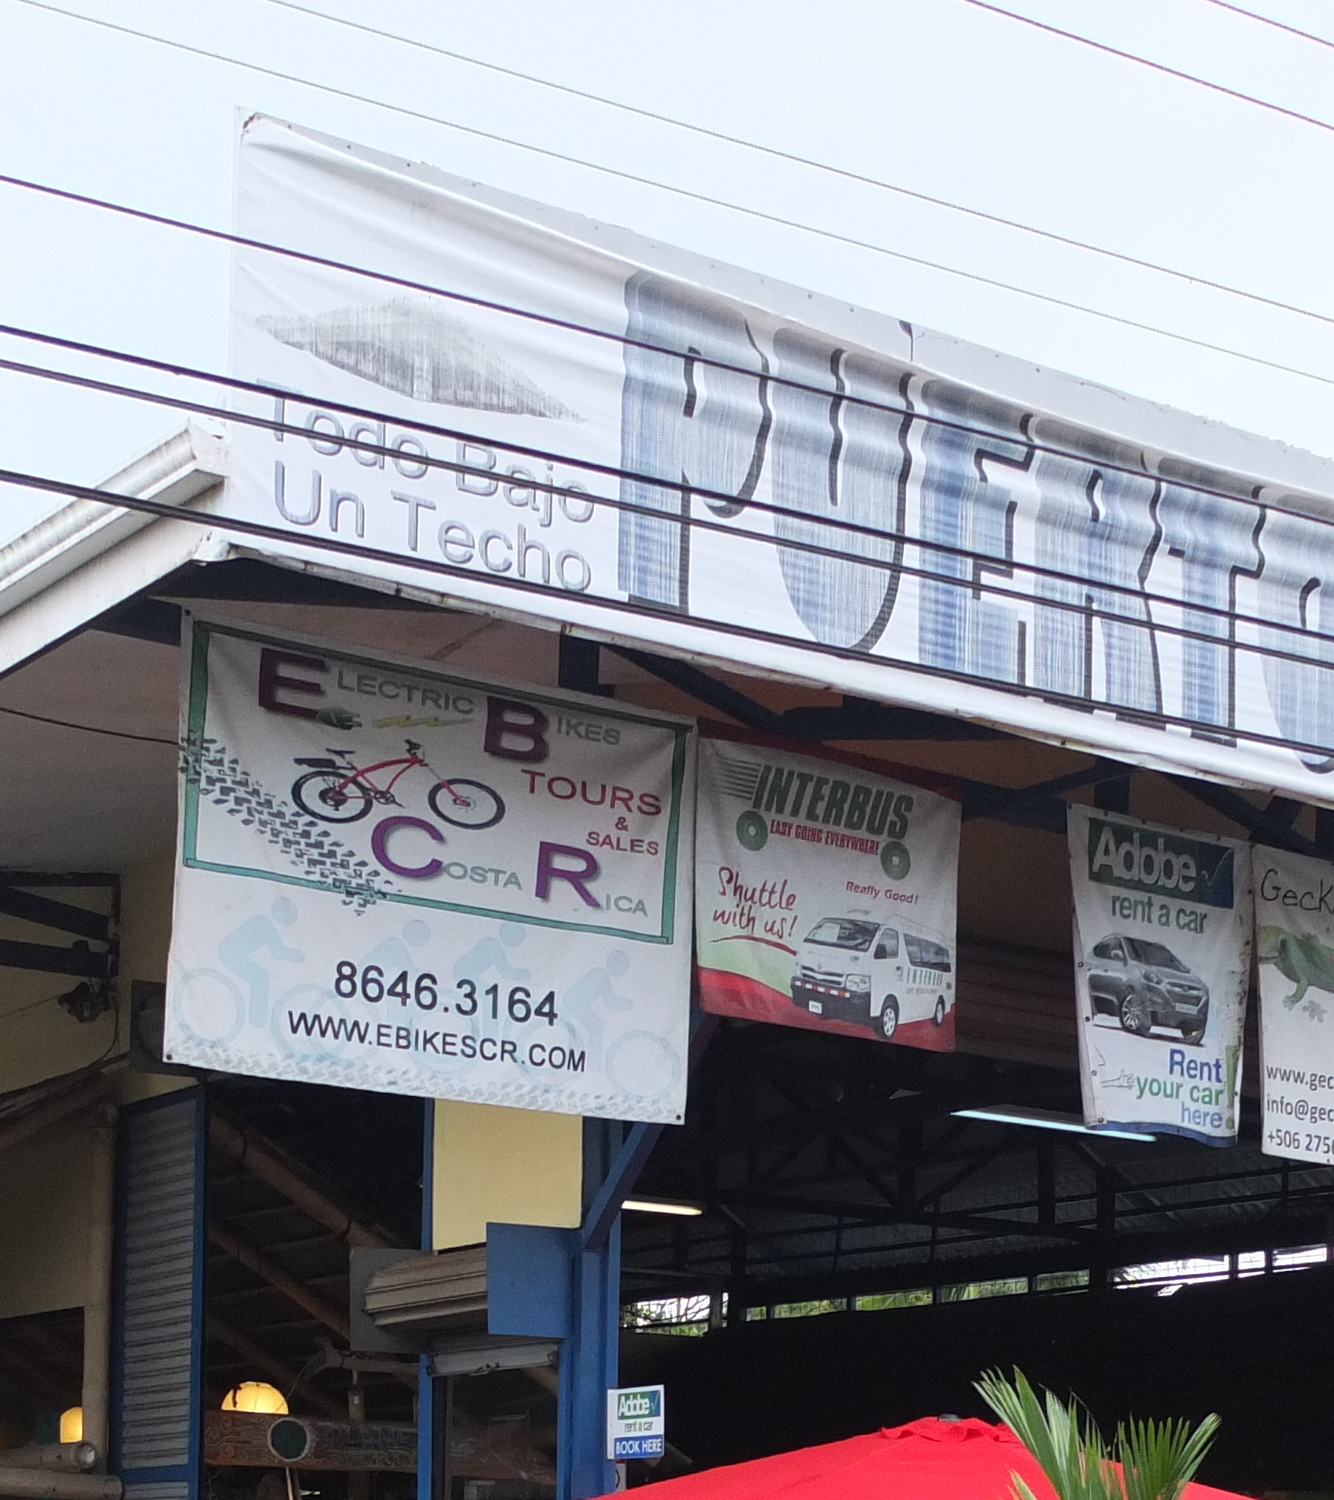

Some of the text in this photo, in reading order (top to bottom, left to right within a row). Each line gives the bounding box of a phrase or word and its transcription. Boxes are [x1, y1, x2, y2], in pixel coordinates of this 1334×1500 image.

[257, 380, 596, 528] Todo Bajo
[272, 459, 592, 594] Un Techo
[258, 647, 621, 764] ELECTRIC BIKES
[521, 768, 662, 817] TOURS
[752, 765, 914, 840] INTERBUS
[614, 816, 629, 831] &
[770, 819, 880, 856] EASY GOING EVERYWHERE
[585, 830, 660, 856] SALES
[1092, 827, 1197, 894] Adobe
[371, 816, 649, 918] COSTA RICA
[717, 866, 797, 911] Shuttle
[846, 881, 919, 905] Really Good!
[713, 904, 799, 940] with us!
[1111, 892, 1208, 936] rent a car
[334, 960, 559, 1027] 8646.3164
[287, 1010, 587, 1074] WWW.EBIKESCR.COM
[1169, 1049, 1223, 1085] Rent
[1136, 1077, 1225, 1107] your car
[1180, 1101, 1223, 1130] here
[1267, 1129, 1301, 1153] +506
[618, 1393, 650, 1417] Adobe
[624, 1421, 637, 1432] rent
[616, 1438, 662, 1454] BOOK HERE
